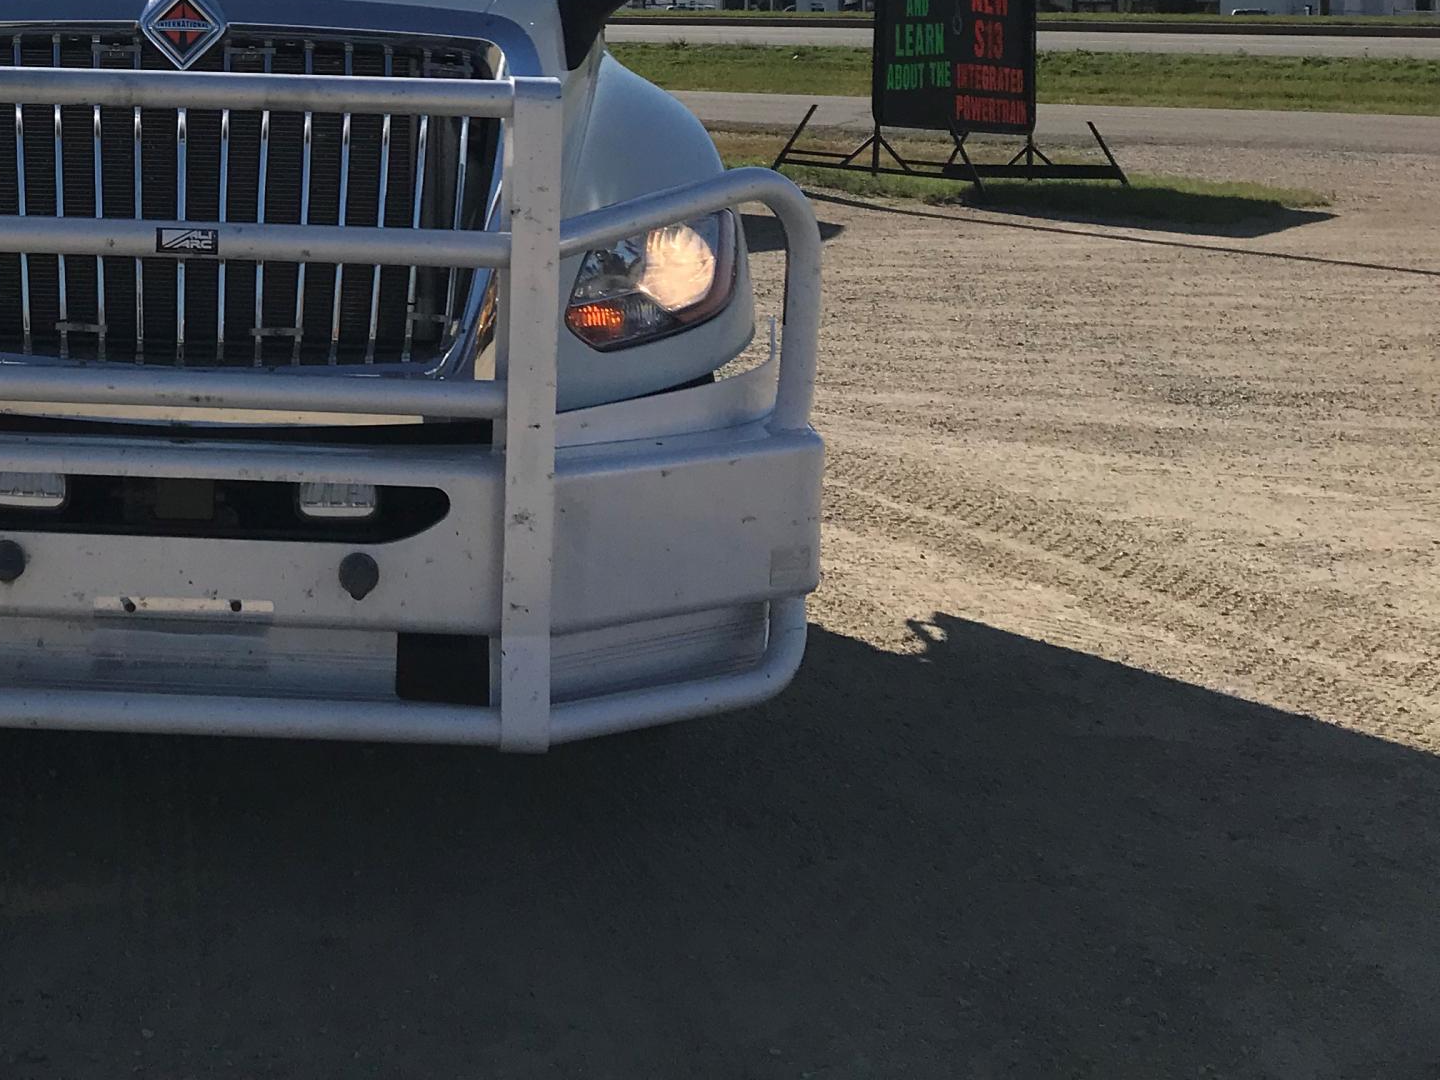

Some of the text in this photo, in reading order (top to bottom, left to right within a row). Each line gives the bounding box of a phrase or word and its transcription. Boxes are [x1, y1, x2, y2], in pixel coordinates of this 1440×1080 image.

[157, 20, 209, 28] INTERNATIONAL
[894, 23, 945, 57] LEARN
[974, 19, 1004, 60] S13
[886, 61, 952, 90] ABOUT THE
[956, 64, 1025, 94] INTEGRATED
[955, 94, 1028, 125] POWERTRAIN
[174, 239, 213, 249] ARC
